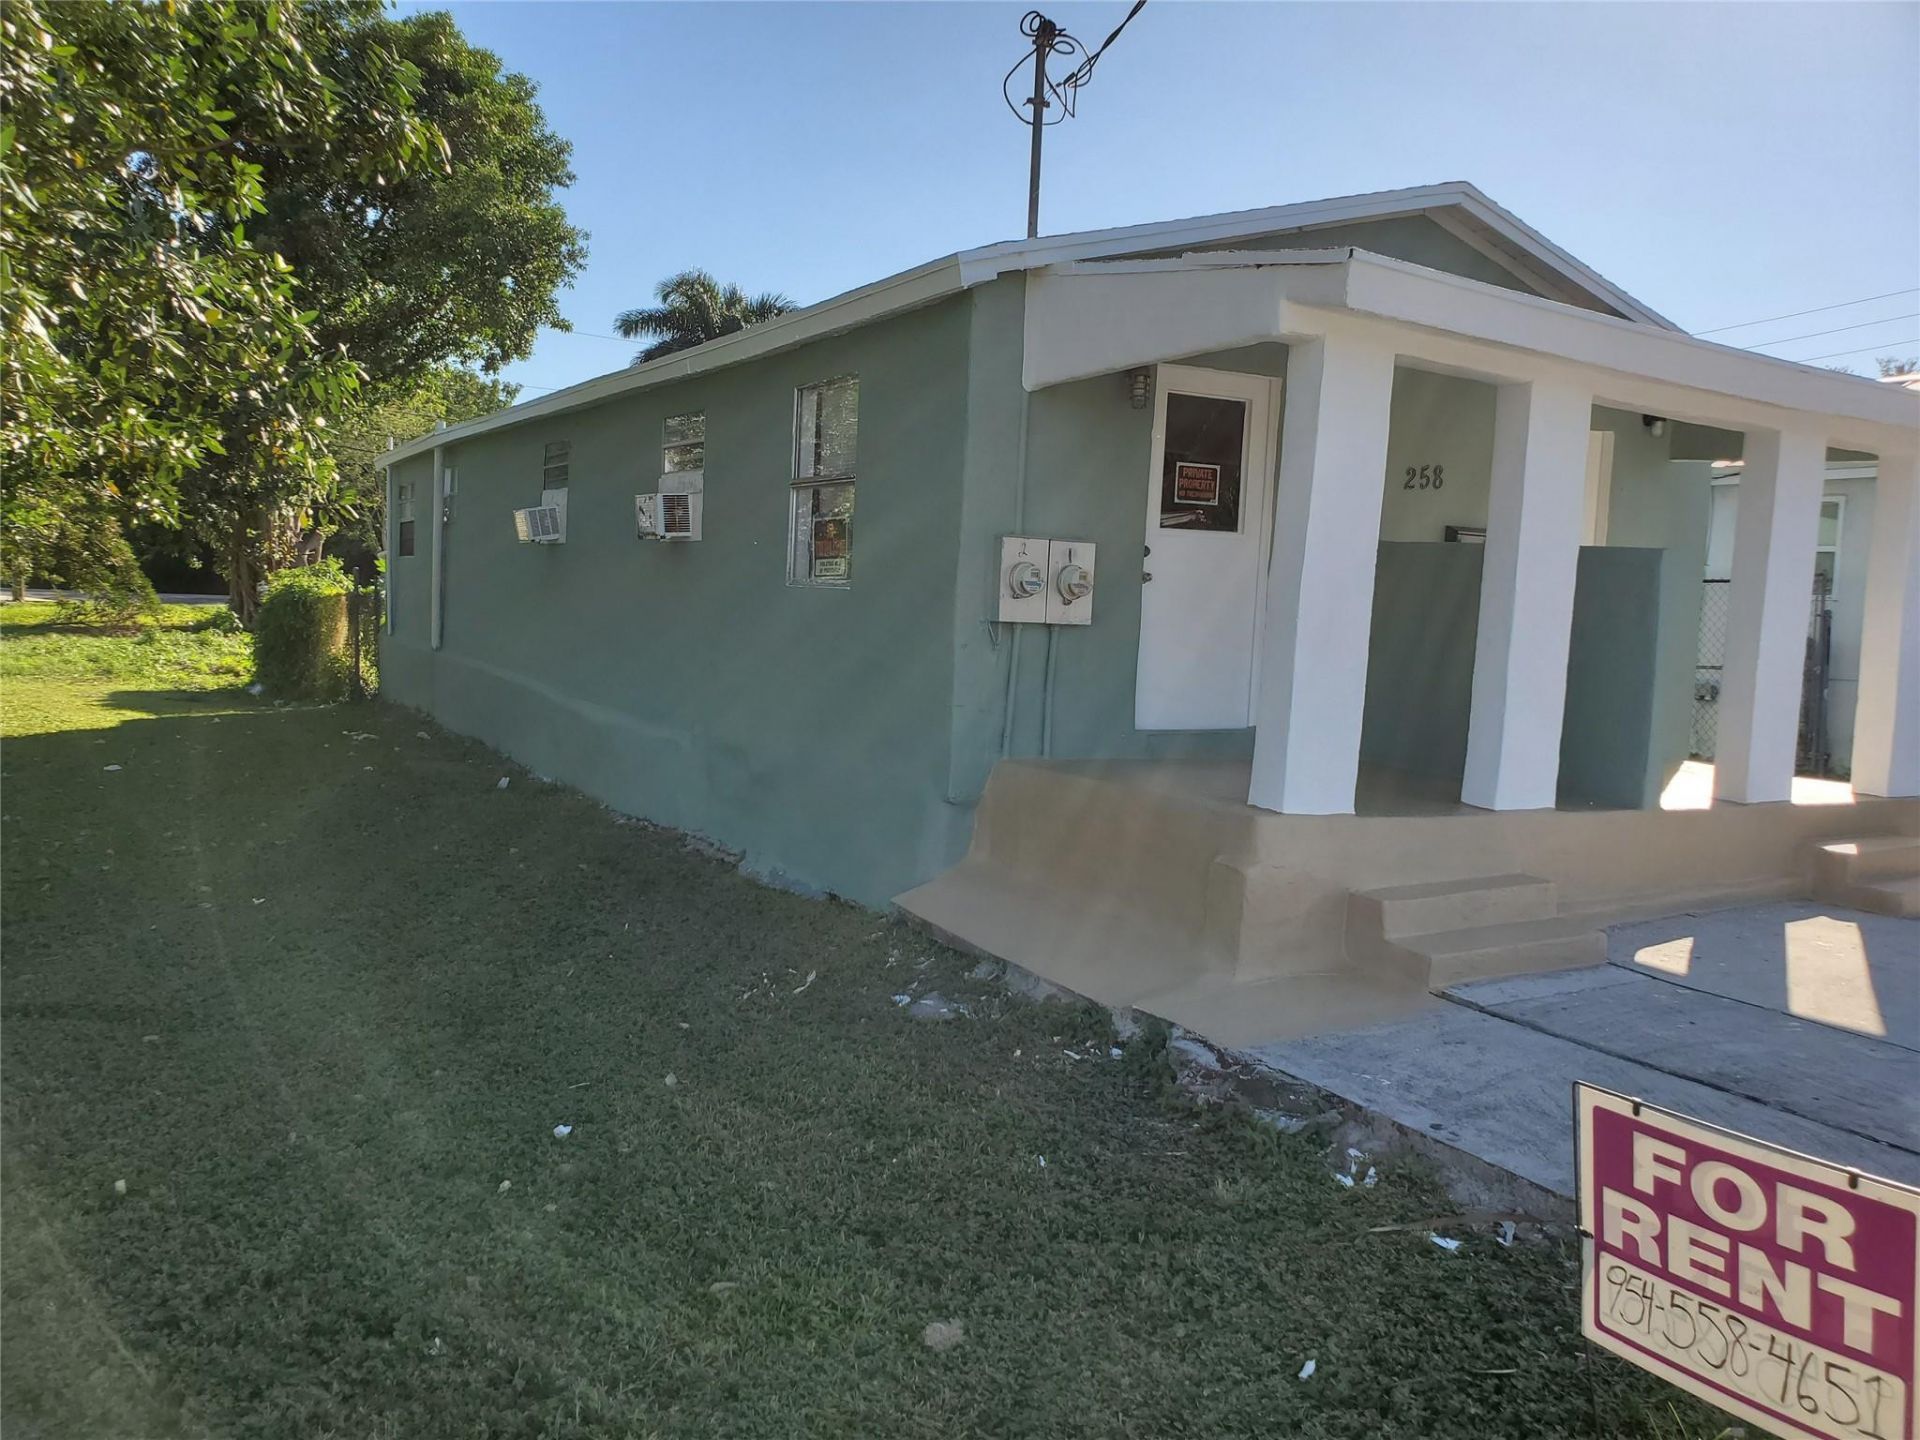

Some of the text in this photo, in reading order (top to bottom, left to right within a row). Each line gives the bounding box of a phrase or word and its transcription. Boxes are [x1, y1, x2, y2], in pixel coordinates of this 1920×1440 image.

[1178, 478, 1216, 492] PROPERTY
[1182, 467, 1213, 480] PRIVATE
[1403, 464, 1443, 490] 258
[1632, 1130, 1857, 1272] FOR
[1602, 1186, 1902, 1355] RENT
[1606, 1265, 1888, 1440] 954-558-4651
